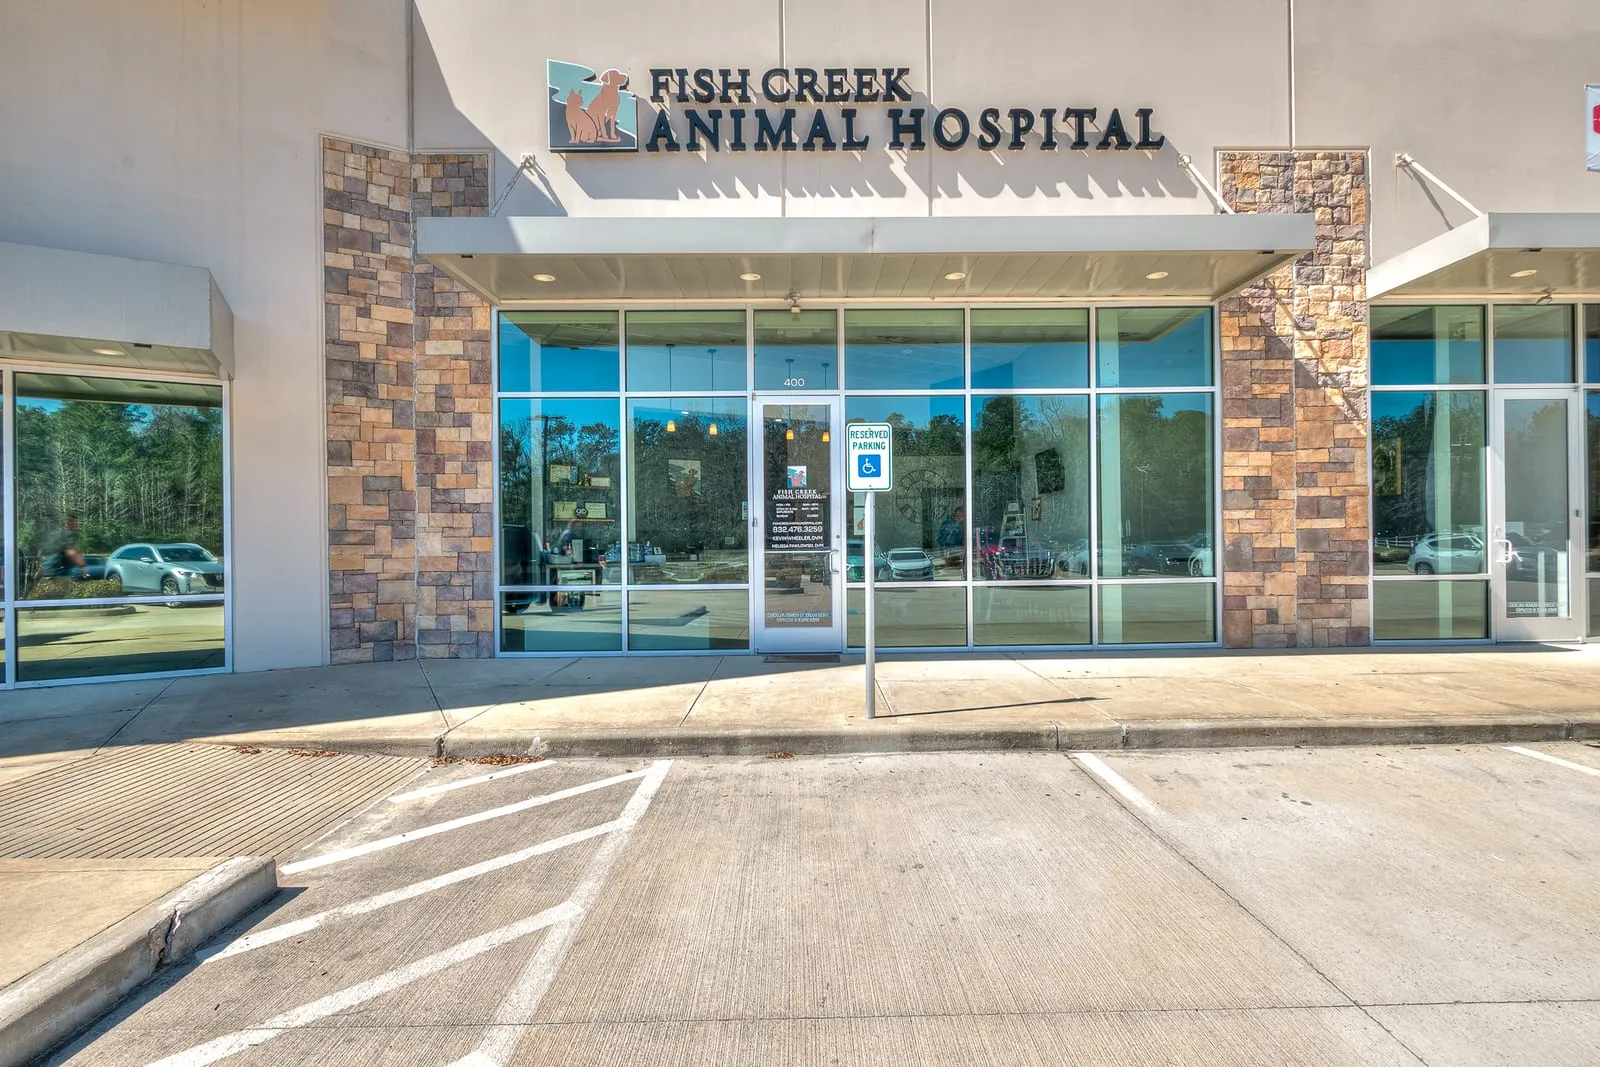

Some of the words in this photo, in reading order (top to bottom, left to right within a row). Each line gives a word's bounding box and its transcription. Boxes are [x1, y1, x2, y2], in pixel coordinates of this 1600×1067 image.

[650, 68, 750, 102] FISH
[762, 68, 912, 102] CREEK
[646, 108, 869, 152] ANIMAL
[888, 108, 1165, 151] HOSPITAL
[783, 378, 805, 387] 400
[850, 430, 889, 439] RESERVED
[852, 442, 886, 450] PARKING
